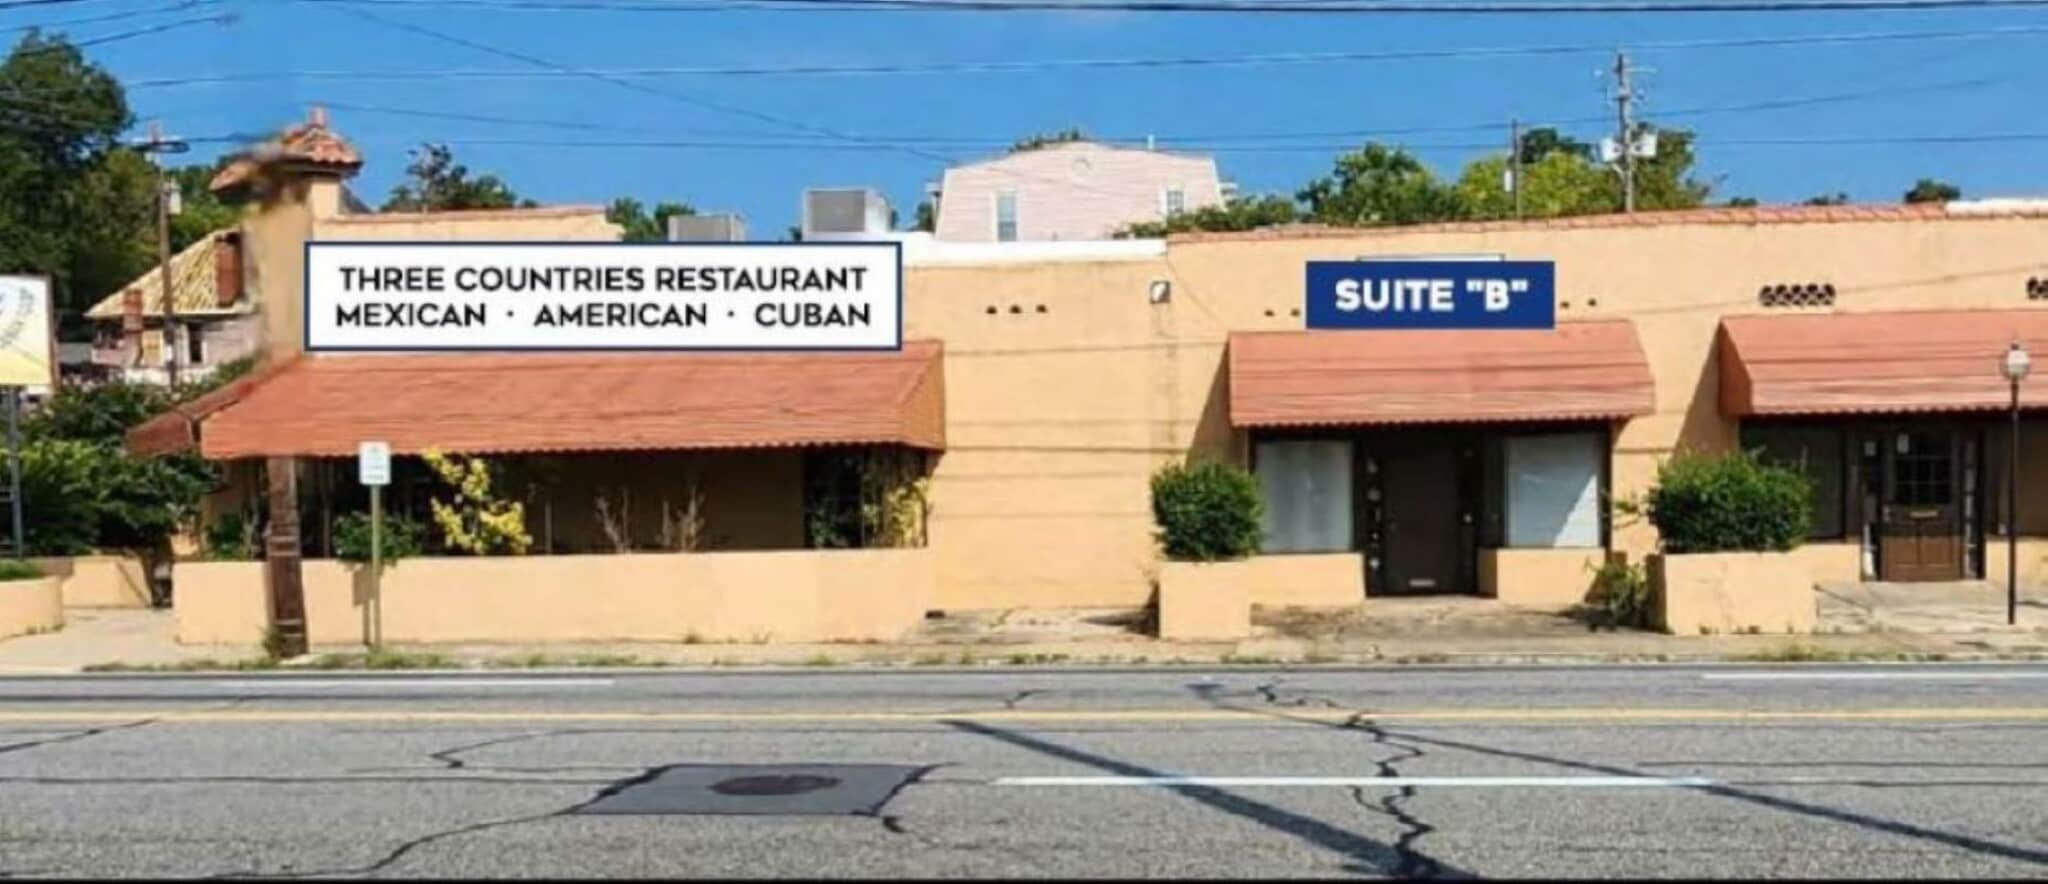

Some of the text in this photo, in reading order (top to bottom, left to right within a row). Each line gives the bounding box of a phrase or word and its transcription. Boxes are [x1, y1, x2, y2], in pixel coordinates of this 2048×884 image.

[339, 267, 867, 292] THREE COUNTRIES RESTAURANT
[1335, 278, 1528, 311] SUITE "B"
[336, 302, 870, 328] MEXICAN AMERICAN CUBAN
